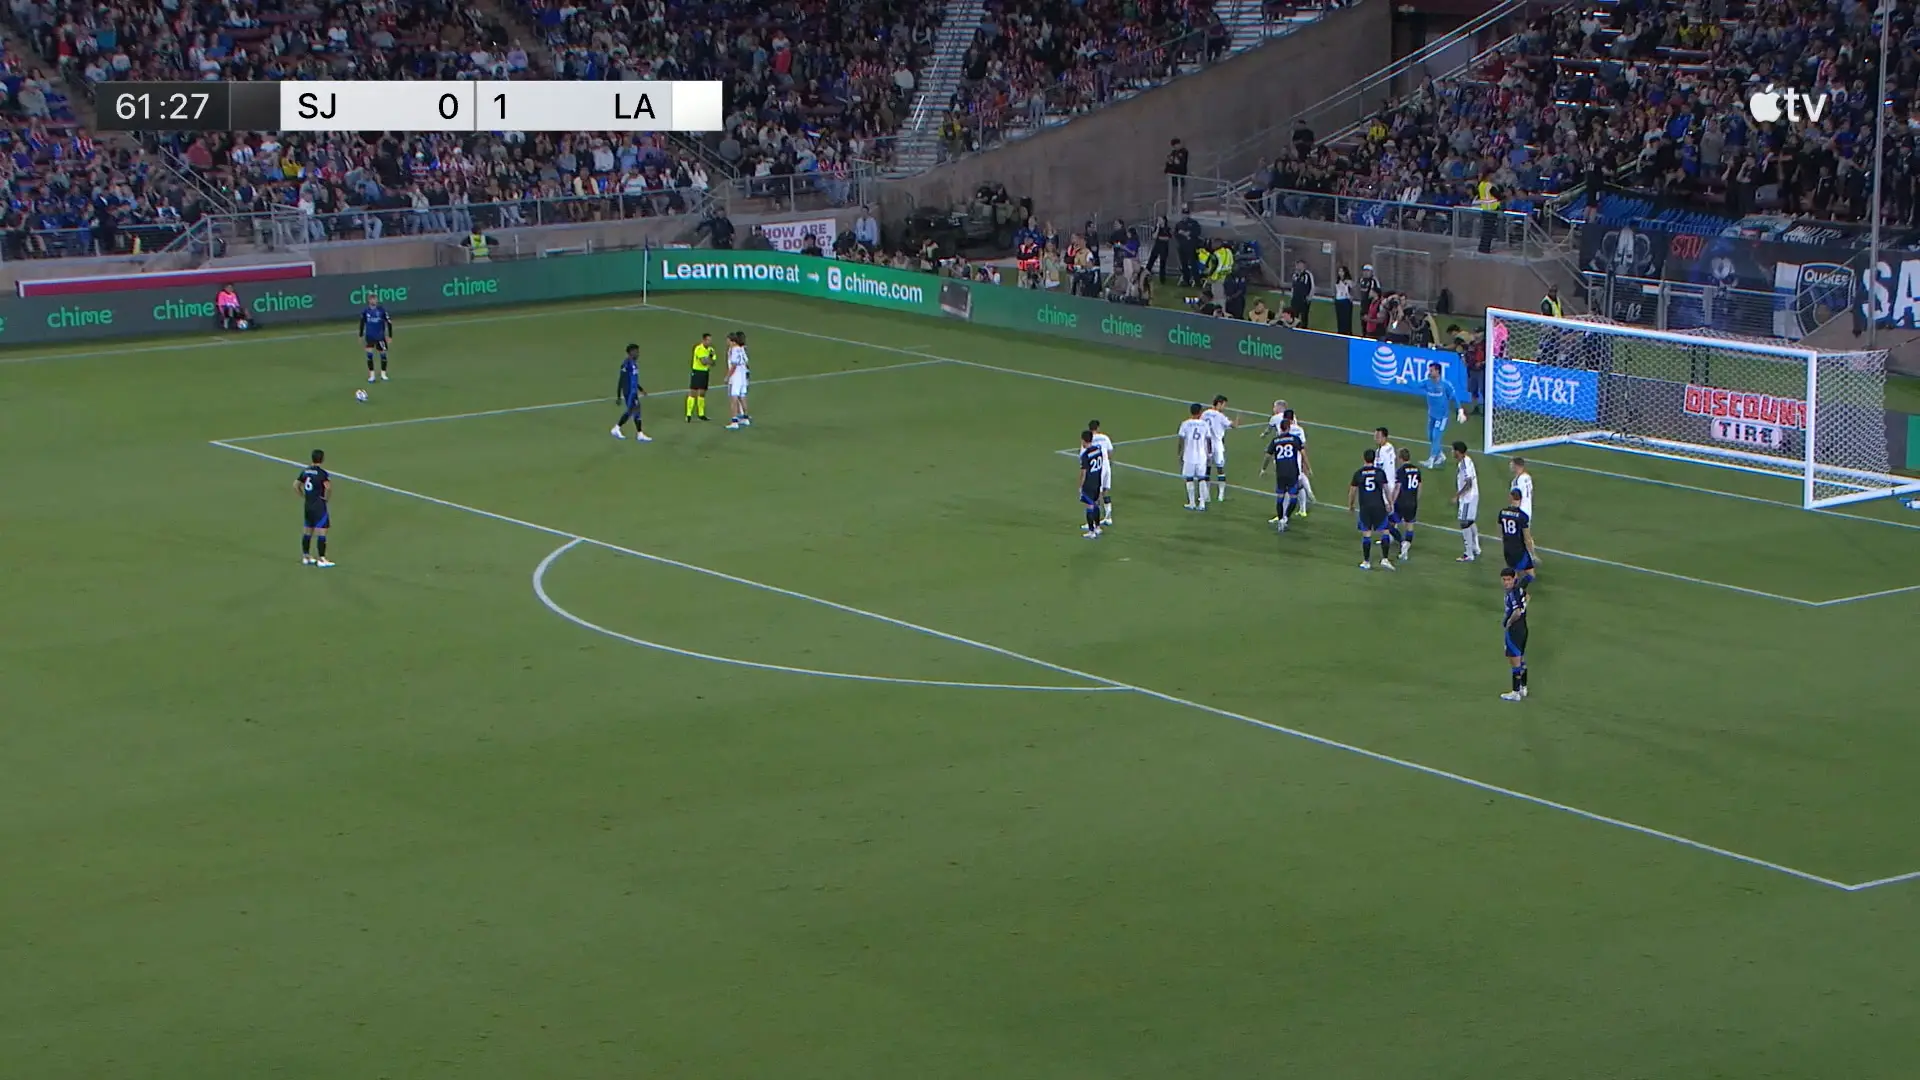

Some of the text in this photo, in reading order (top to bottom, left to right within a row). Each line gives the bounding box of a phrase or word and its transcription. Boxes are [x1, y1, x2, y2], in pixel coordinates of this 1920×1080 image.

[763, 223, 827, 239] HOW ARE
[783, 236, 832, 250] DOG?
[662, 259, 800, 283] Learn more at
[442, 276, 498, 297] chime
[844, 272, 923, 303] chime.com
[153, 300, 215, 321] chime
[253, 291, 313, 313] chime
[47, 306, 113, 329] chime
[1037, 304, 1077, 328] chime
[1101, 314, 1142, 338] chime
[1168, 324, 1212, 349] chime
[1238, 335, 1283, 361] chime
[1527, 375, 1580, 405] AT&T
[1684, 385, 1807, 430] DISCOUNT
[1192, 427, 1201, 441] 6
[1719, 421, 1773, 443] TIRE
[1275, 444, 1294, 460] 28
[1089, 456, 1102, 473] 20
[304, 476, 313, 491] 6
[1364, 476, 1376, 491] 5
[1407, 474, 1419, 489] 16
[1501, 518, 1517, 535] 18
